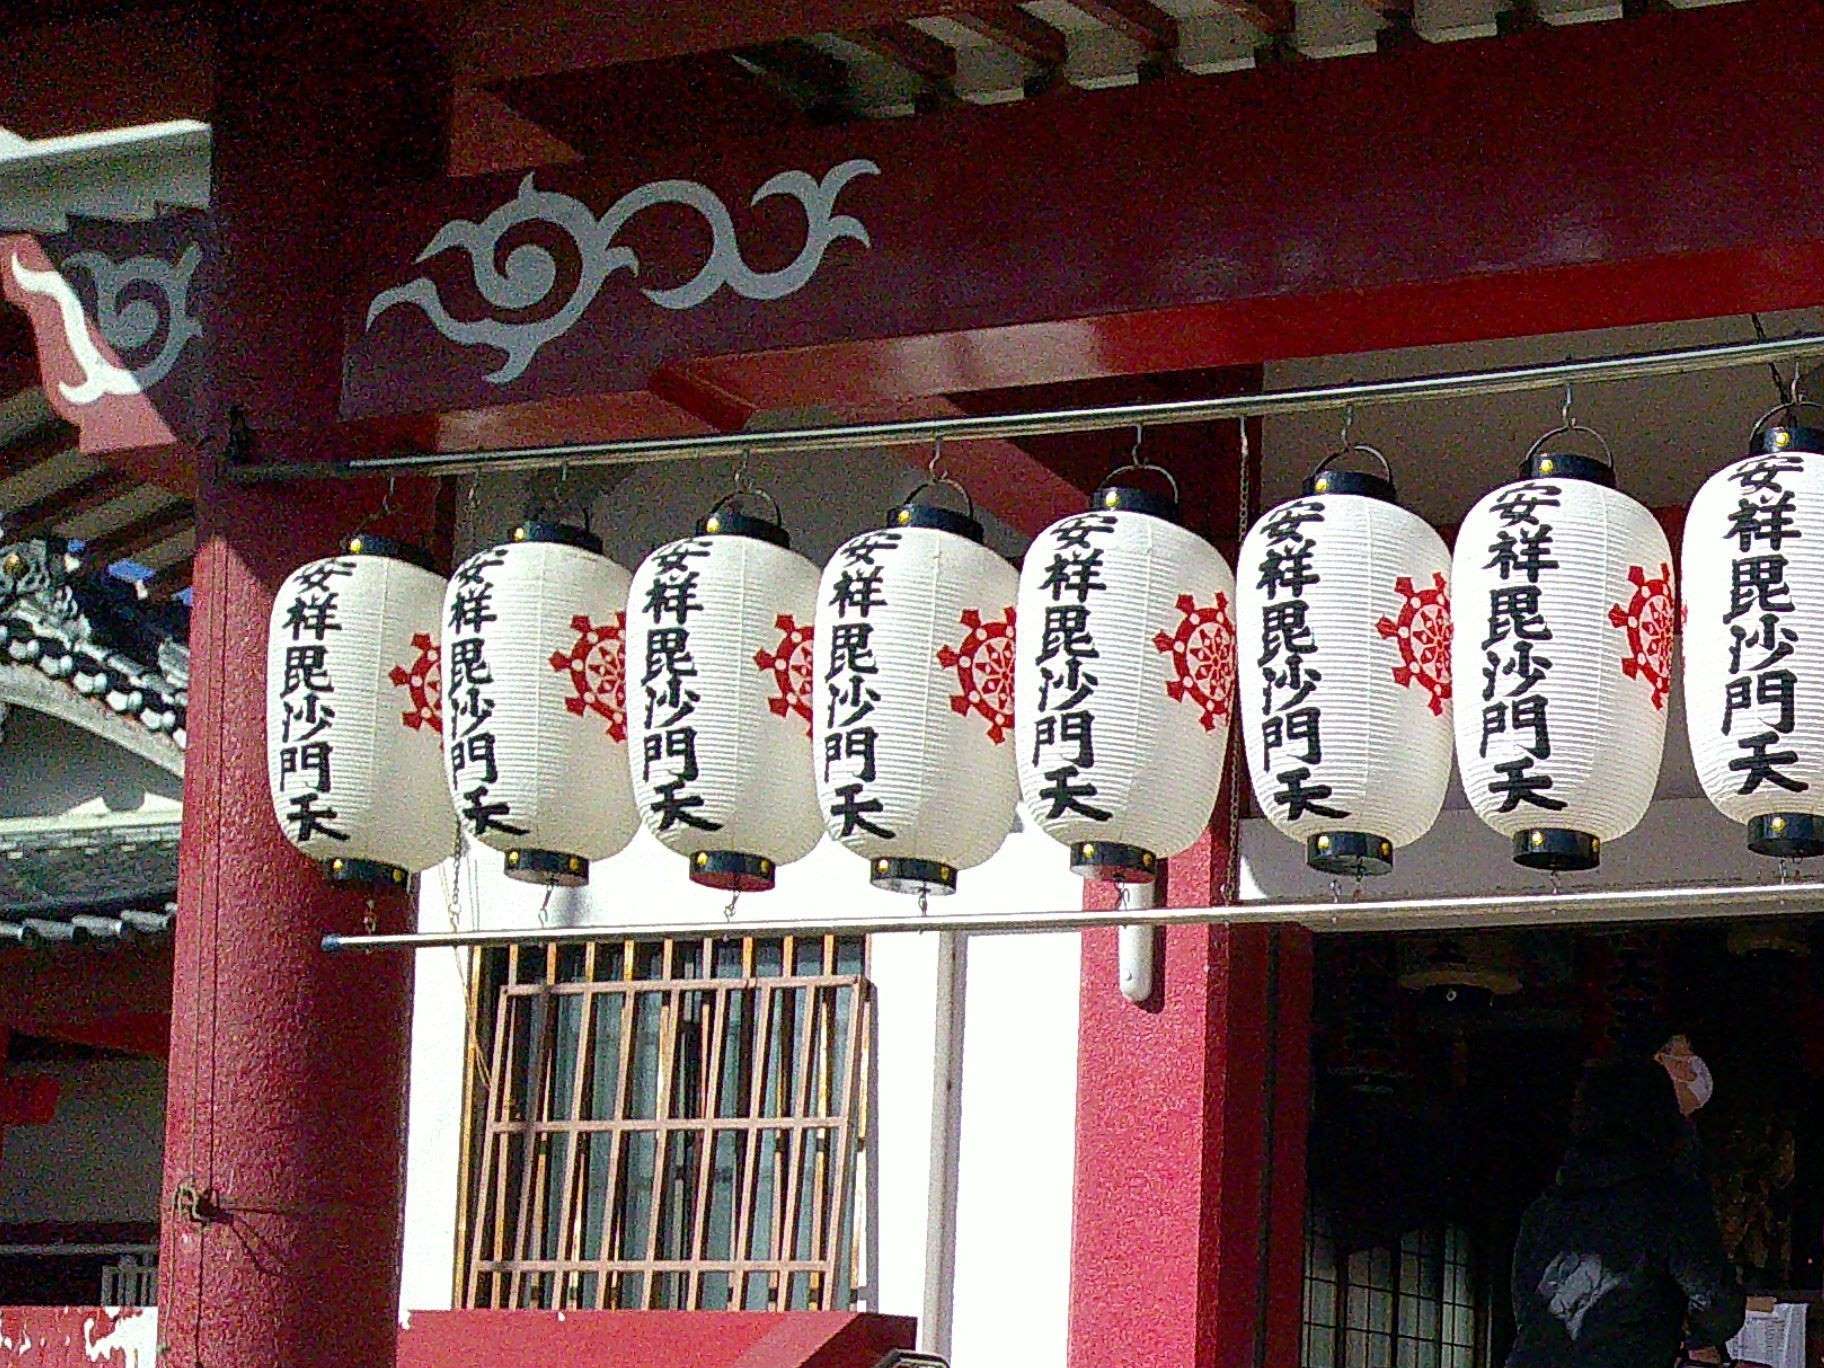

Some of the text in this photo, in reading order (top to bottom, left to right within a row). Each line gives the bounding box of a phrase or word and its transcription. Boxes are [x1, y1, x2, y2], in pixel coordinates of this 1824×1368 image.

[279, 560, 357, 843] 安祥毘沙門天
[448, 548, 530, 839] 安祥毘沙門天
[640, 540, 724, 833] 安祥毘沙門天
[823, 530, 906, 841] 安祥毘沙門天
[1034, 513, 1115, 822] 安祥毘沙門天
[1256, 500, 1352, 820] 安祥毘沙門天
[1479, 482, 1568, 813] 安祥毘沙門天
[1722, 454, 1810, 795] 安祥毘沙門天
